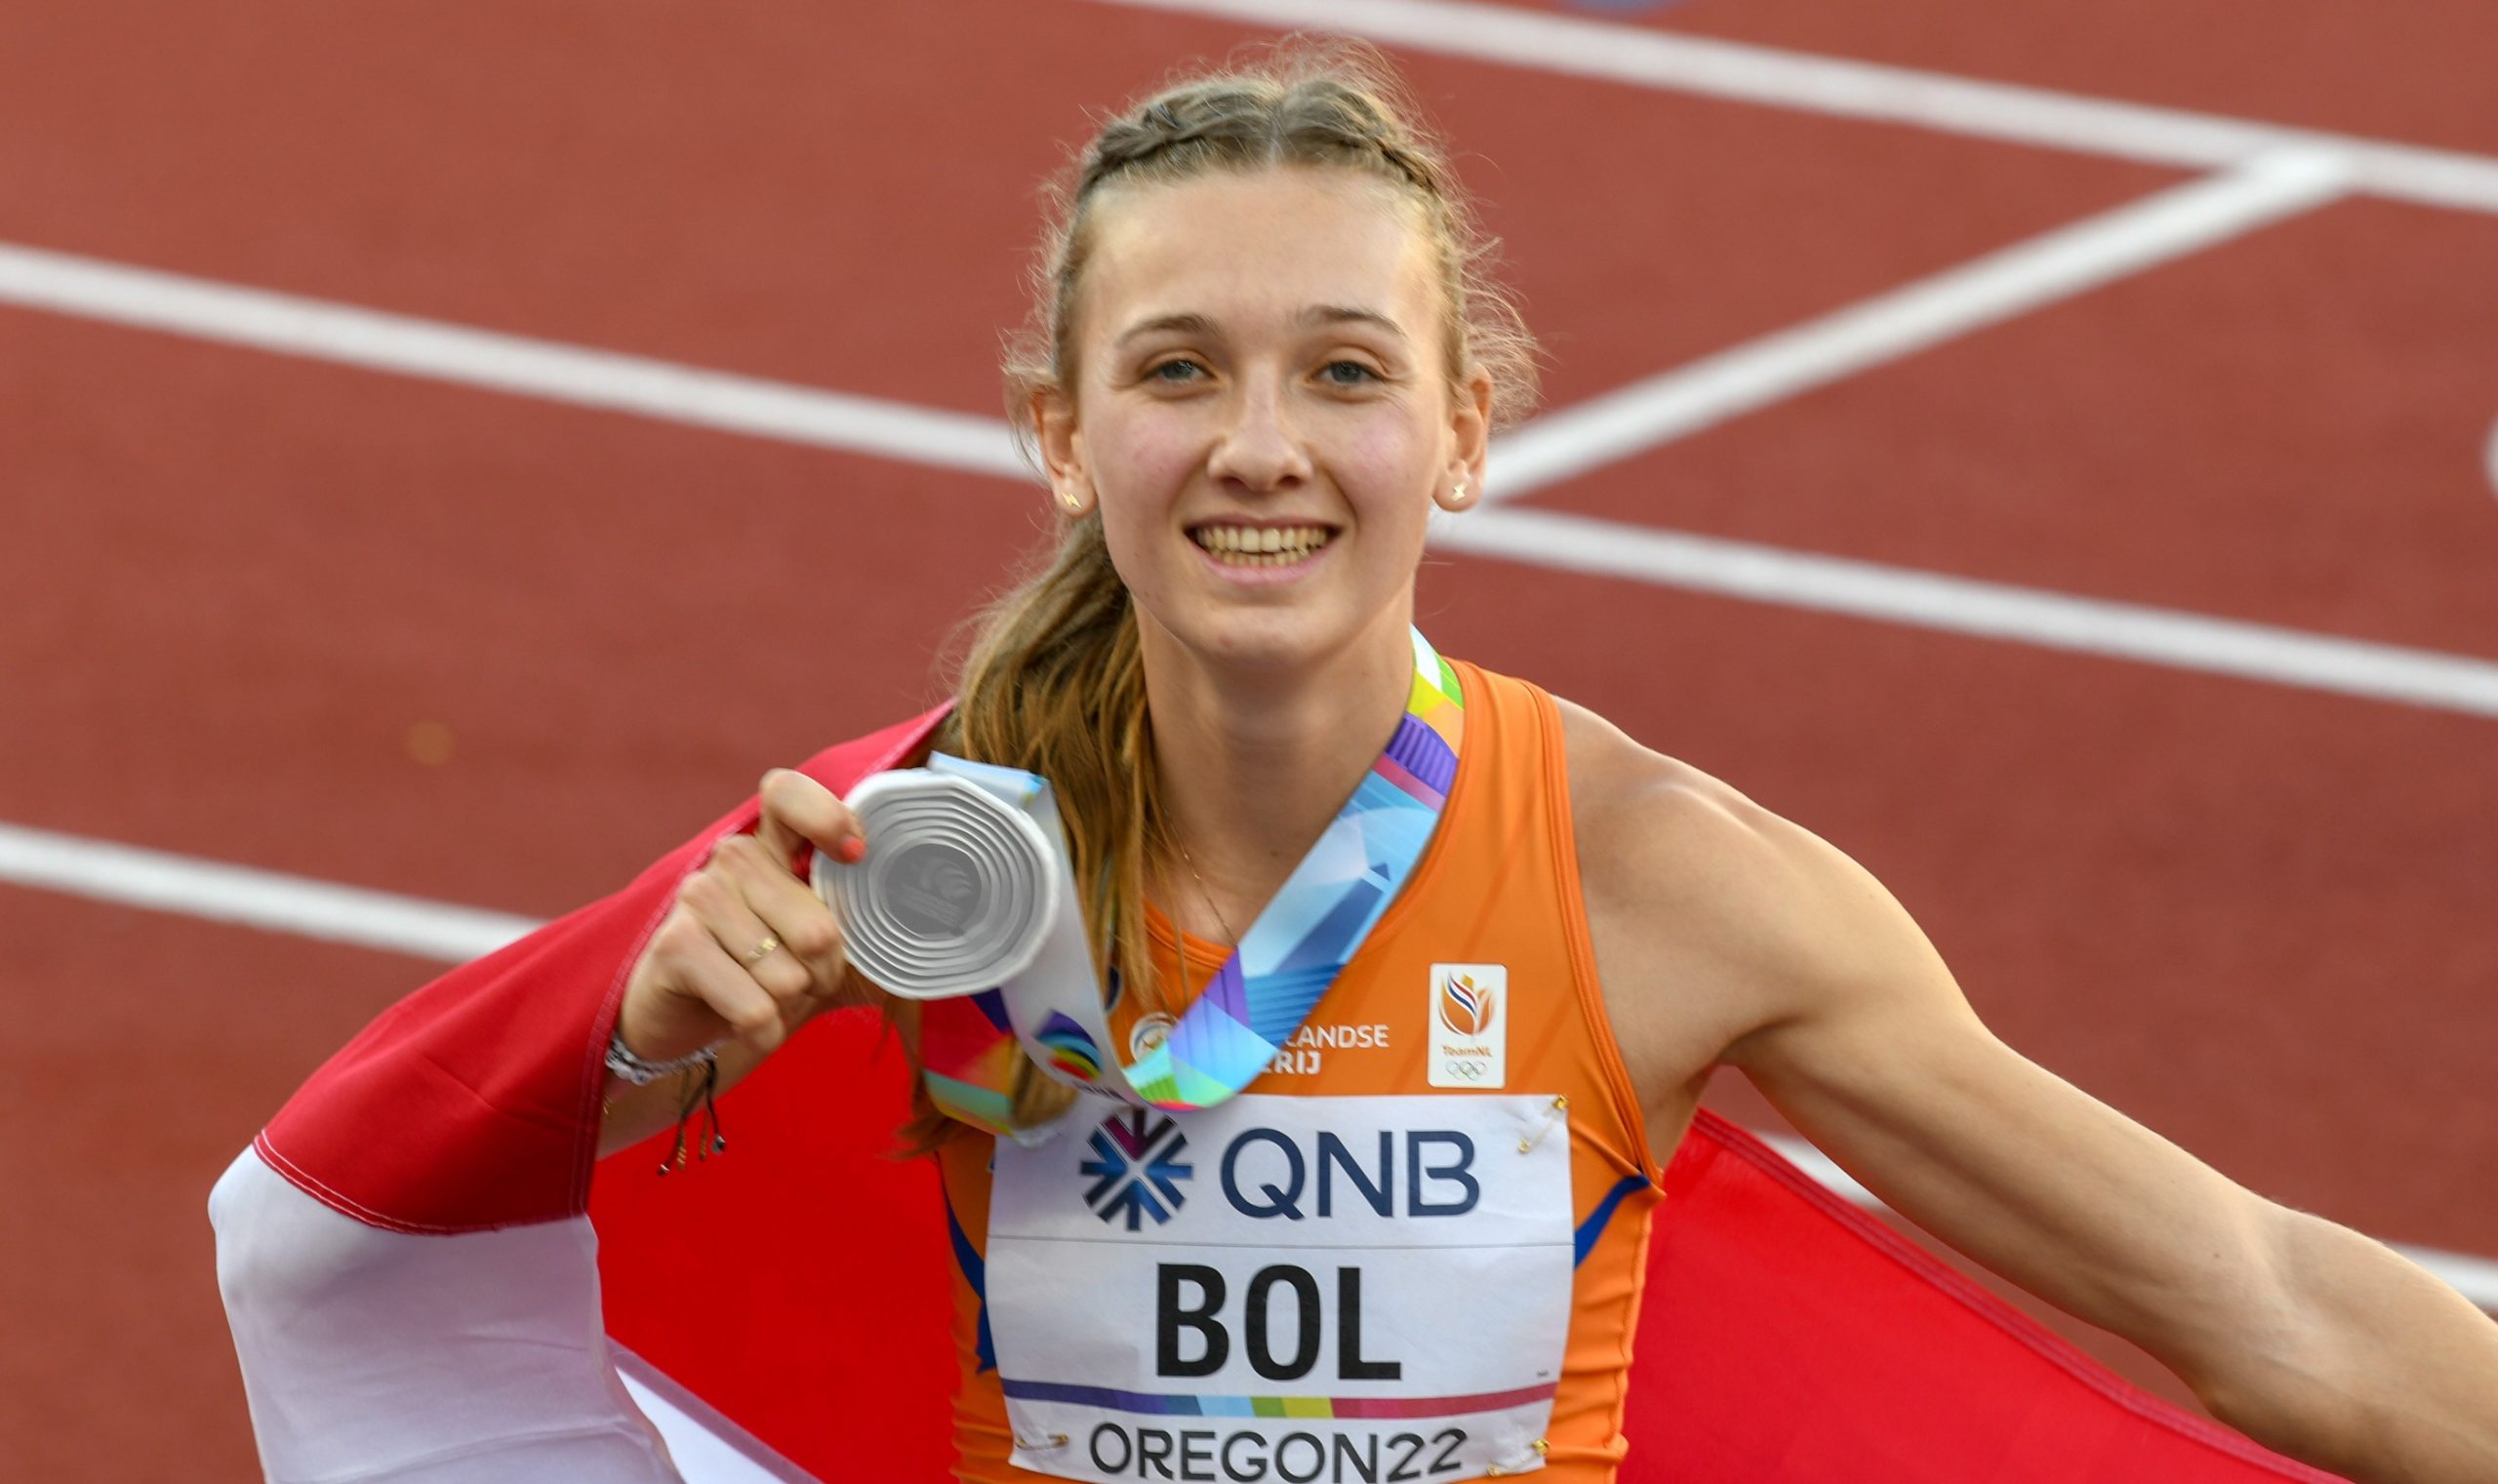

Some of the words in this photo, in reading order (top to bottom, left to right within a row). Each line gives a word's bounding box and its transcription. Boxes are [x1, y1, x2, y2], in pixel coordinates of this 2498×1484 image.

[1261, 1050, 1322, 1075] RIJ
[1441, 1044, 1493, 1058] TeamNL
[1220, 1127, 1481, 1221] QNB
[1156, 1262, 1402, 1381] BOL
[1089, 1422, 1469, 1484] OREGON22
